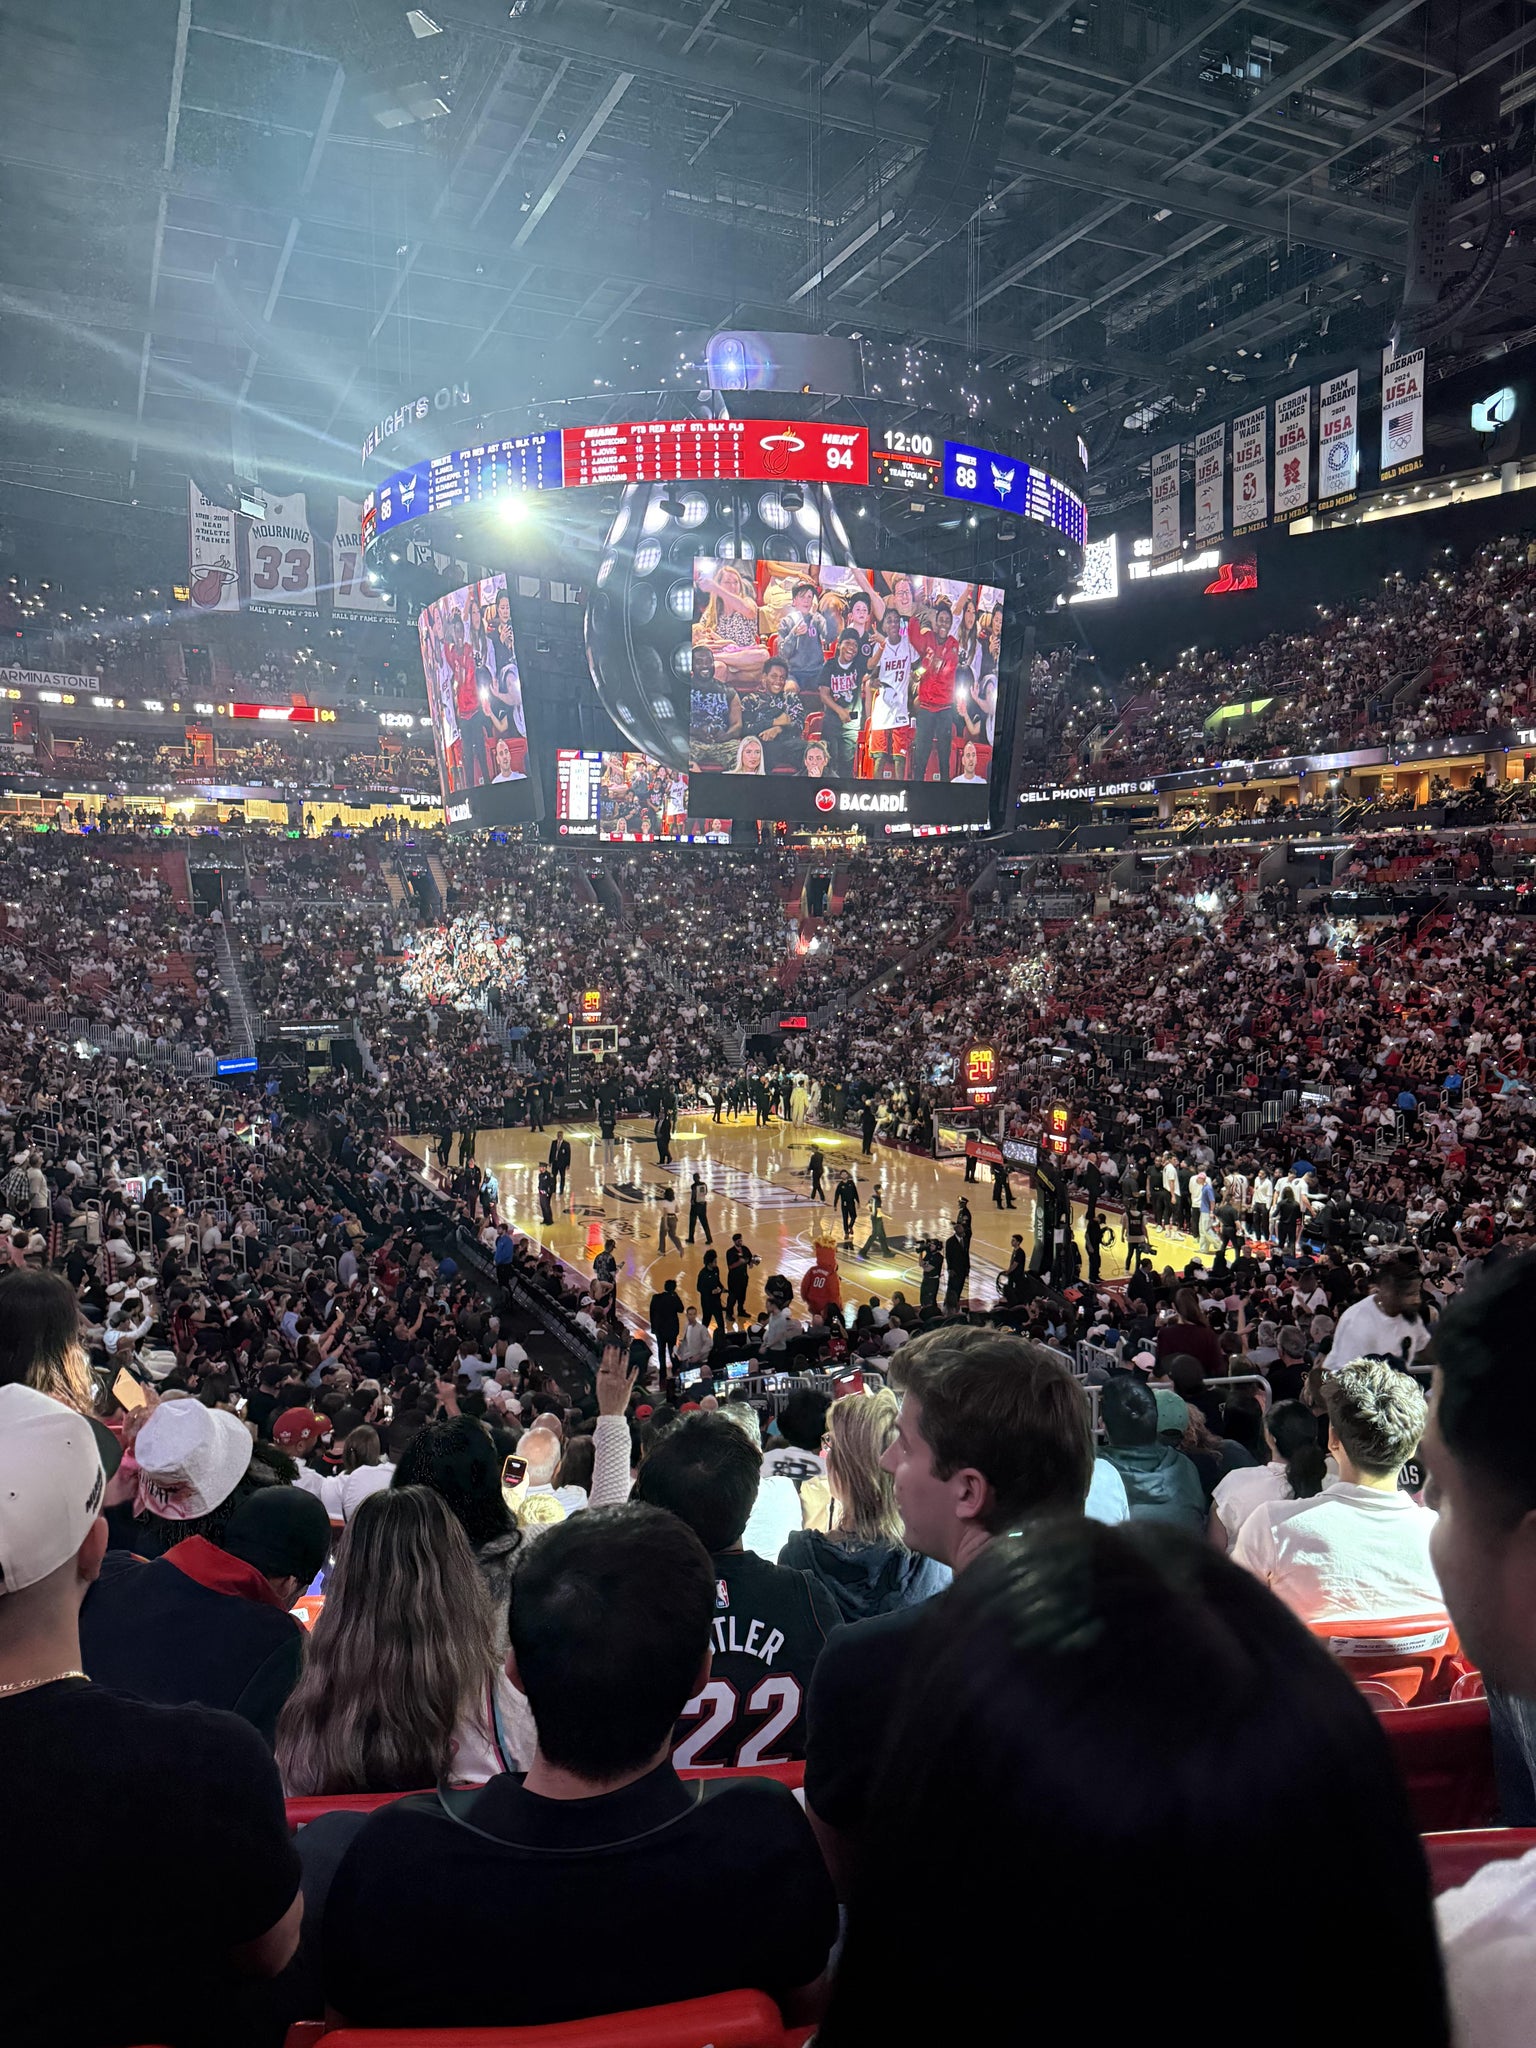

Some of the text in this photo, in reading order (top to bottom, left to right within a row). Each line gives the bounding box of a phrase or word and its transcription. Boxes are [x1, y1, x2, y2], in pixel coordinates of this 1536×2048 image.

[1384, 350, 1424, 376] ADEBAYO
[1330, 378, 1348, 394] BAM
[1386, 378, 1418, 402] USA
[1278, 393, 1308, 413] LEBRON
[1321, 385, 1356, 408] ADEBAYO
[374, 396, 429, 447] LIGHTS
[434, 381, 471, 410] ON
[1234, 410, 1265, 432] DWYANE
[1279, 404, 1305, 424] JAMES
[584, 422, 744, 438] MIAMI PTS REB AST STL BLK FLS
[1239, 422, 1261, 440] WADE
[1324, 415, 1353, 437] USA
[822, 433, 859, 446] HEAT
[884, 430, 932, 455] 12:00
[1279, 427, 1306, 448] USA
[460, 450, 472, 461] PTS
[487, 443, 499, 454] AST
[502, 441, 514, 450] STL
[515, 438, 529, 449] BLK
[532, 435, 546, 445] FLS
[635, 445, 644, 453] 10
[1236, 443, 1262, 463] USA
[580, 458, 587, 466] 11
[635, 454, 644, 462] 10
[826, 448, 853, 469] 94
[902, 462, 914, 471] TOL
[1160, 452, 1171, 465] TIM
[1399, 459, 1424, 476] MEDAL
[889, 468, 907, 478] TEAM
[907, 470, 927, 481] FOULS
[956, 466, 977, 489] 88
[1199, 460, 1219, 480] USA
[904, 479, 914, 487] CC
[1155, 478, 1176, 498] USA
[1335, 493, 1357, 507] MEDAL
[381, 499, 392, 521] 88
[195, 528, 230, 537] ATHLETIC
[202, 521, 222, 529] HEAD
[1248, 520, 1268, 533] MEDAL
[195, 535, 231, 544] TRAINER
[252, 525, 309, 544] MOURNING
[254, 545, 312, 592] 33
[278, 608, 296, 617] FAME
[884, 656, 908, 671] HEAT
[895, 671, 904, 683] 13
[117, 700, 125, 708] 4
[217, 705, 225, 714] 0
[320, 710, 336, 722] 94
[379, 712, 414, 727] 12:00
[400, 794, 441, 805] TURN
[1020, 779, 1156, 803] CELL PHONE LIGHTS ON
[970, 1050, 992, 1062] 12:00
[969, 1061, 991, 1080] 24
[1053, 1118, 1065, 1131] 24
[813, 1276, 826, 1288] 00
[671, 1671, 804, 1770] 22
